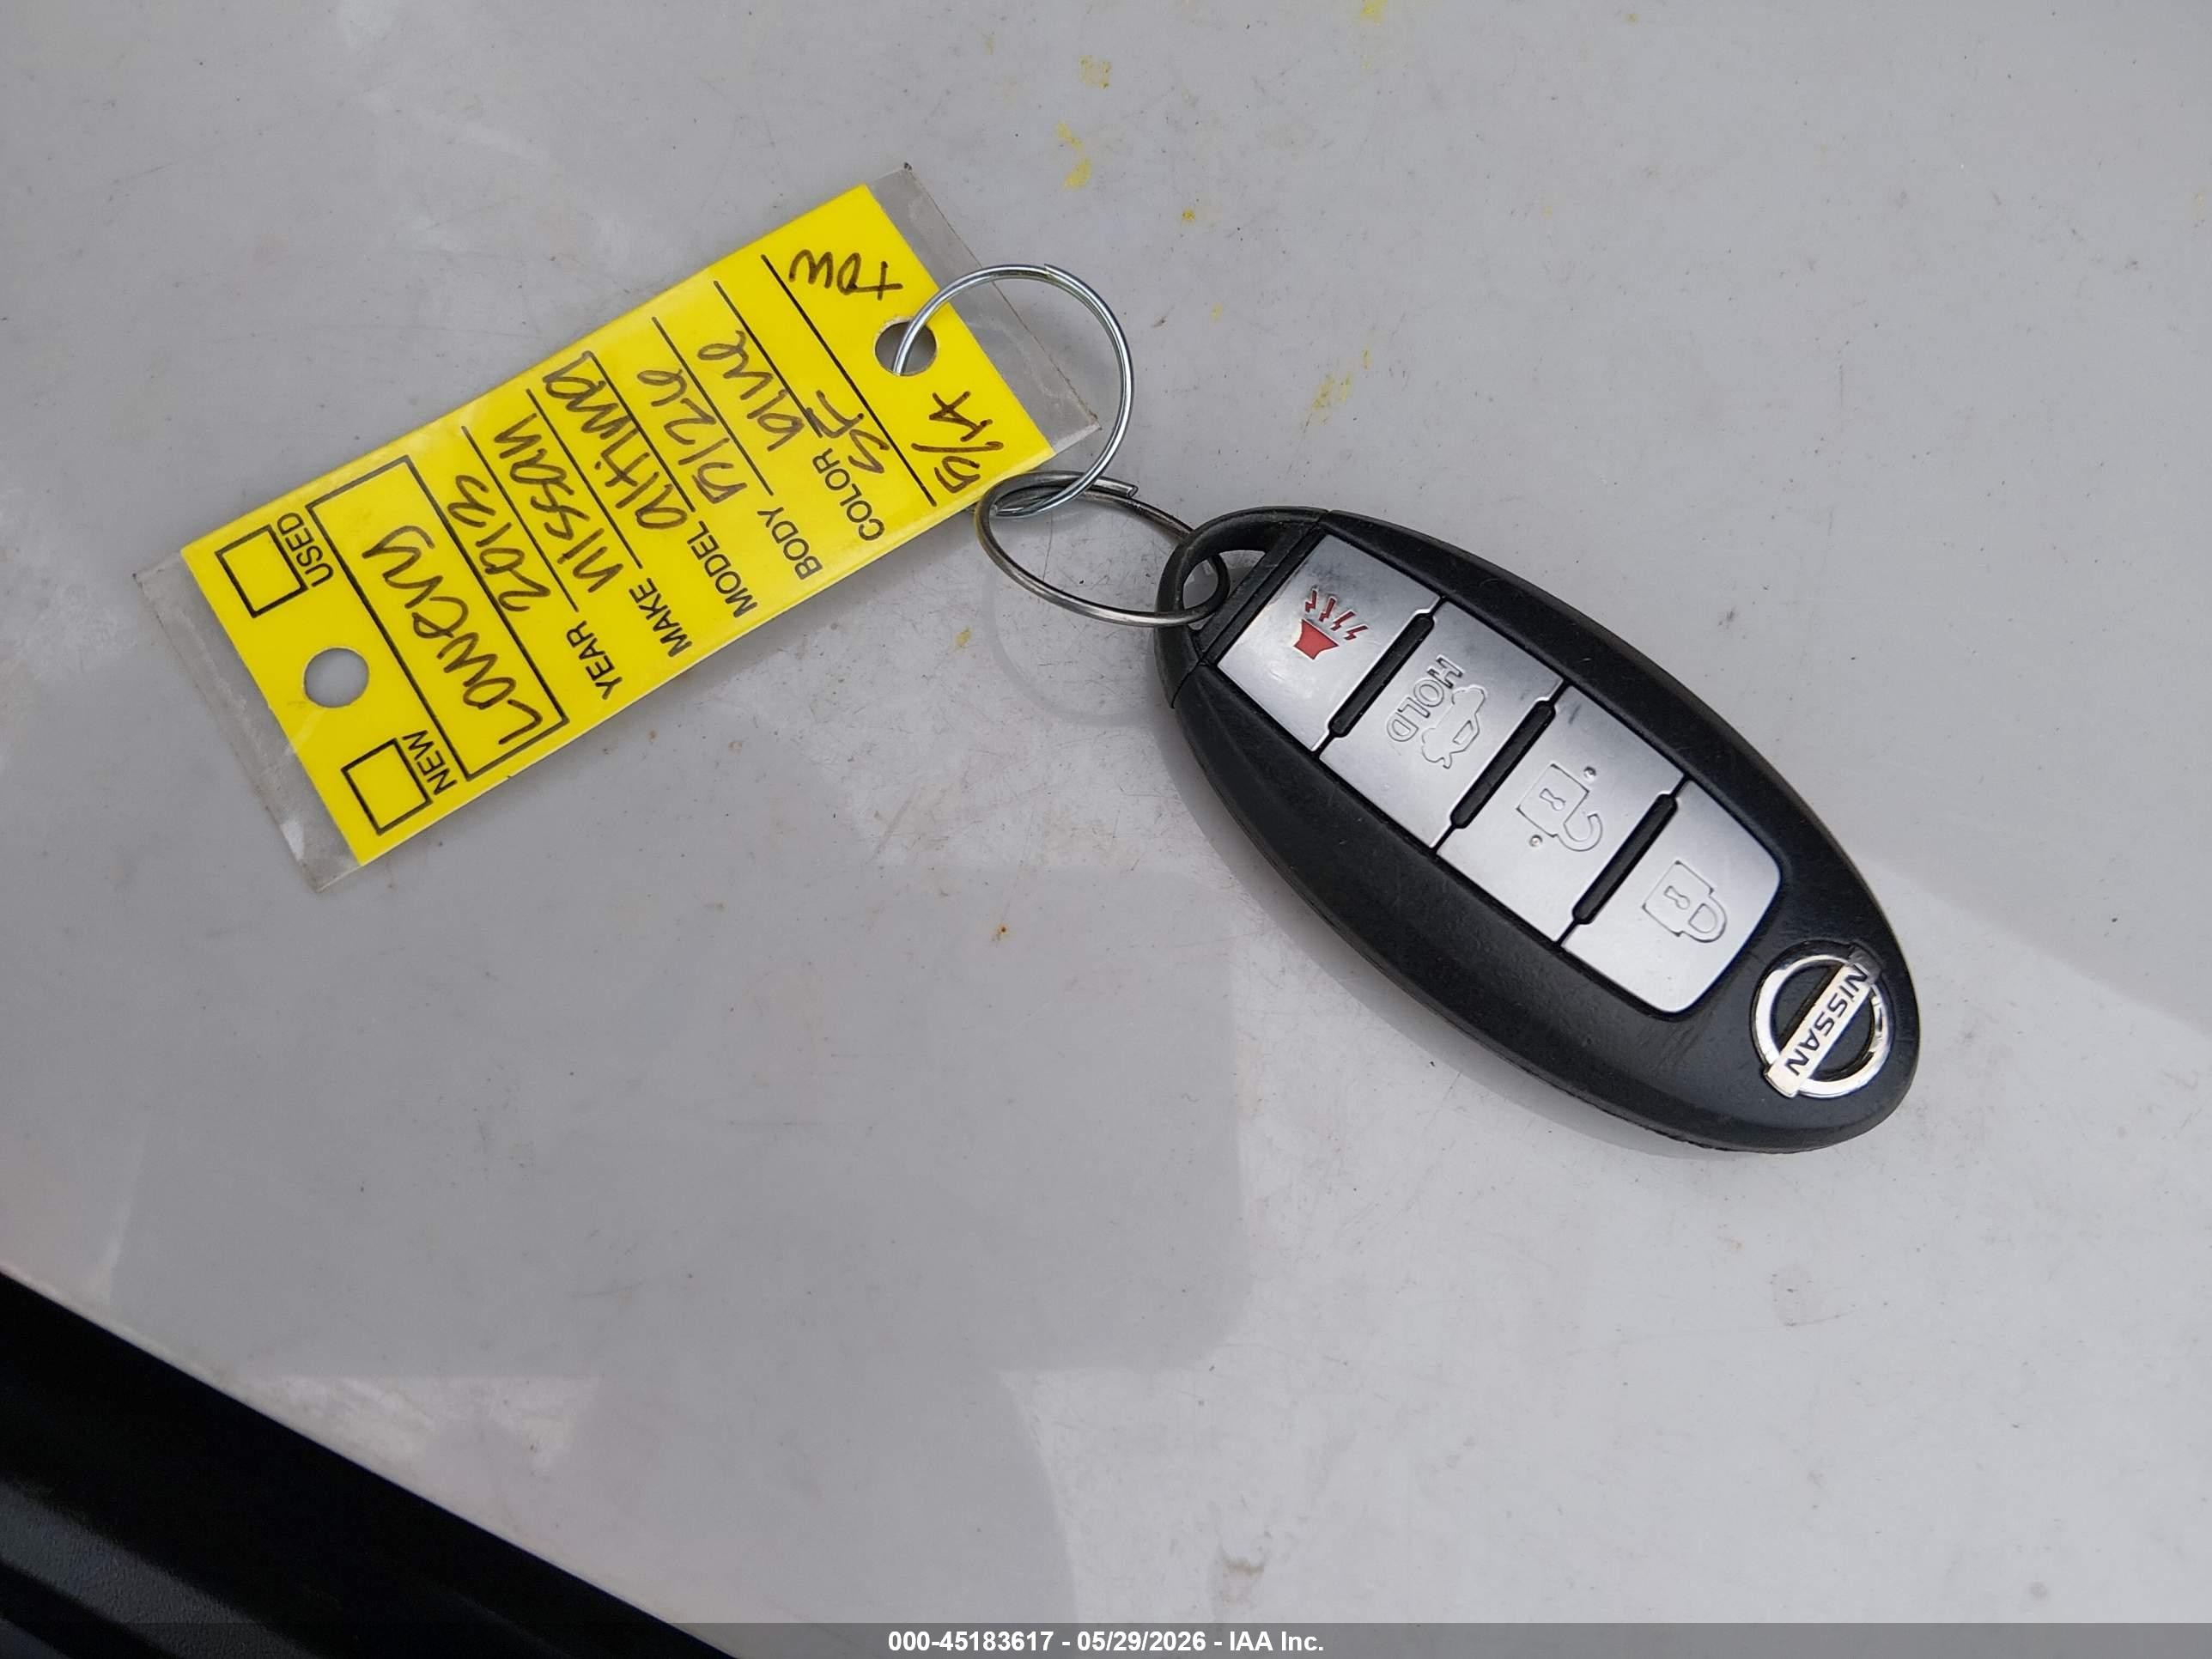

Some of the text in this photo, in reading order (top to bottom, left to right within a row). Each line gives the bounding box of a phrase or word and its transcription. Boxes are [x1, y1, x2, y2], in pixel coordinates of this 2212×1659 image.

[697, 331, 806, 452] blue
[806, 390, 890, 474] SF
[542, 350, 688, 530] altima
[911, 391, 1004, 493] 5/14
[812, 447, 884, 542] COLOR
[276, 512, 335, 587] USED
[448, 474, 551, 612] 2013
[686, 520, 758, 617] MODEL
[757, 506, 823, 580] BODY
[566, 620, 623, 700] YEAR
[629, 577, 693, 658] MAKE
[1386, 653, 1463, 742] HOLD
[403, 729, 457, 796] NEW
[1785, 963, 1870, 1077] NISSAN
